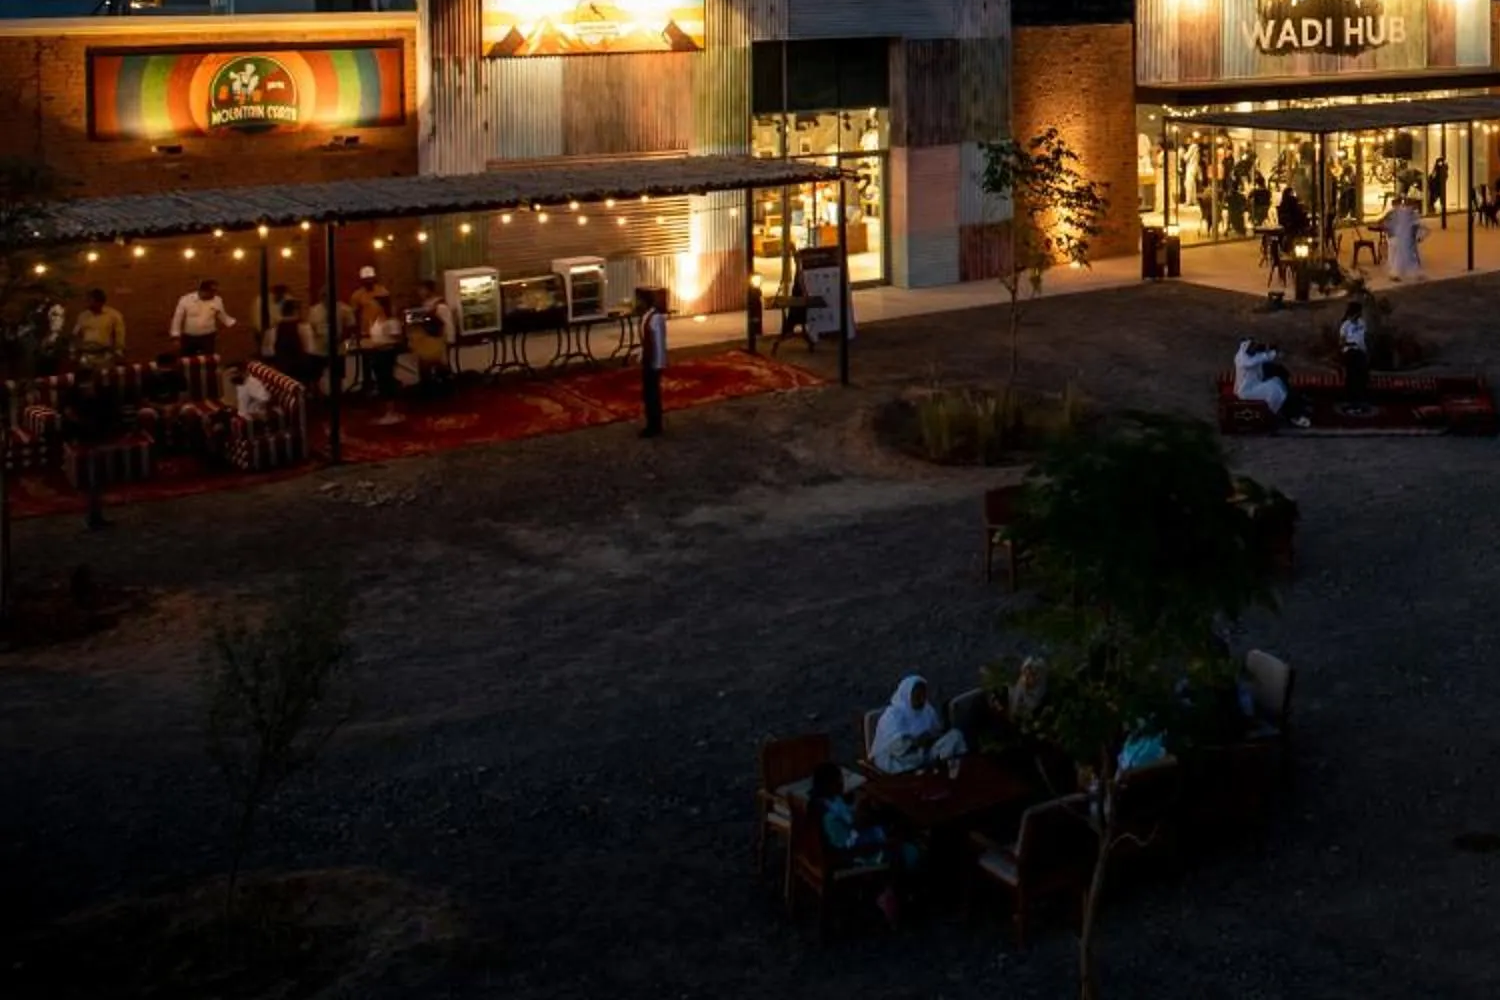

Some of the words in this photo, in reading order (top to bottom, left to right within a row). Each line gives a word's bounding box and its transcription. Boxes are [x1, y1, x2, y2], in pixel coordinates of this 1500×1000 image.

[1242, 18, 1333, 49] WADI
[1344, 16, 1407, 46] HUB
[212, 106, 264, 125] MOUNTAIN
